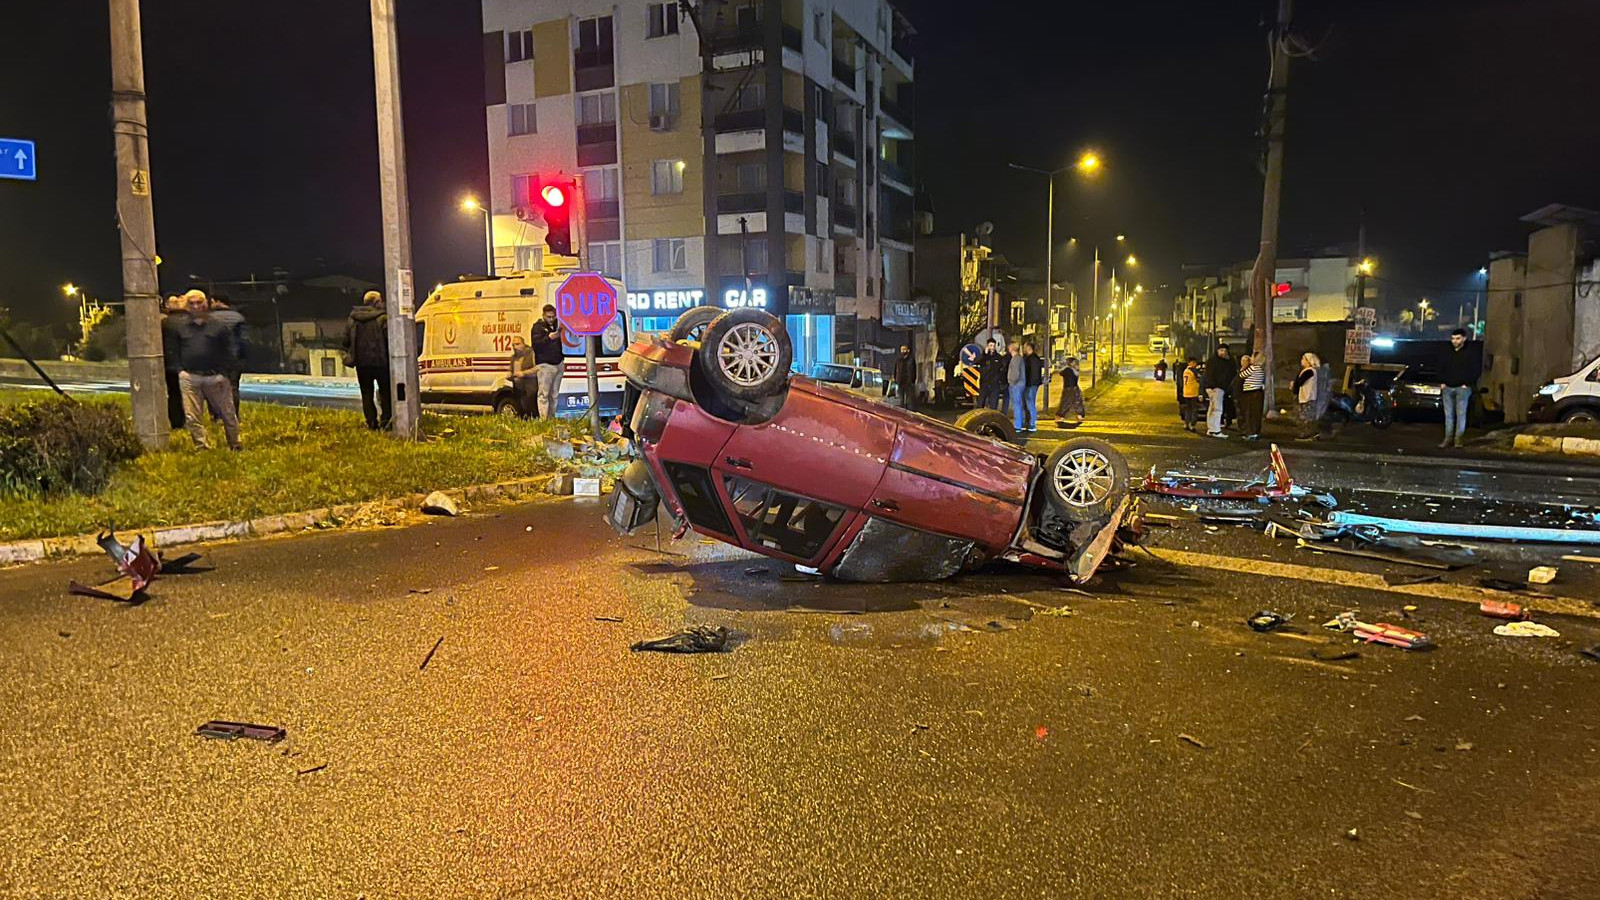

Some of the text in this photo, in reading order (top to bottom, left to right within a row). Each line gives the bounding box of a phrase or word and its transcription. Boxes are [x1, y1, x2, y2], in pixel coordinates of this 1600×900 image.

[561, 292, 611, 317] DUR
[654, 290, 703, 309] RENT
[725, 289, 767, 307] CAR
[493, 335, 512, 352] 112
[431, 358, 467, 368] AMBULANS
